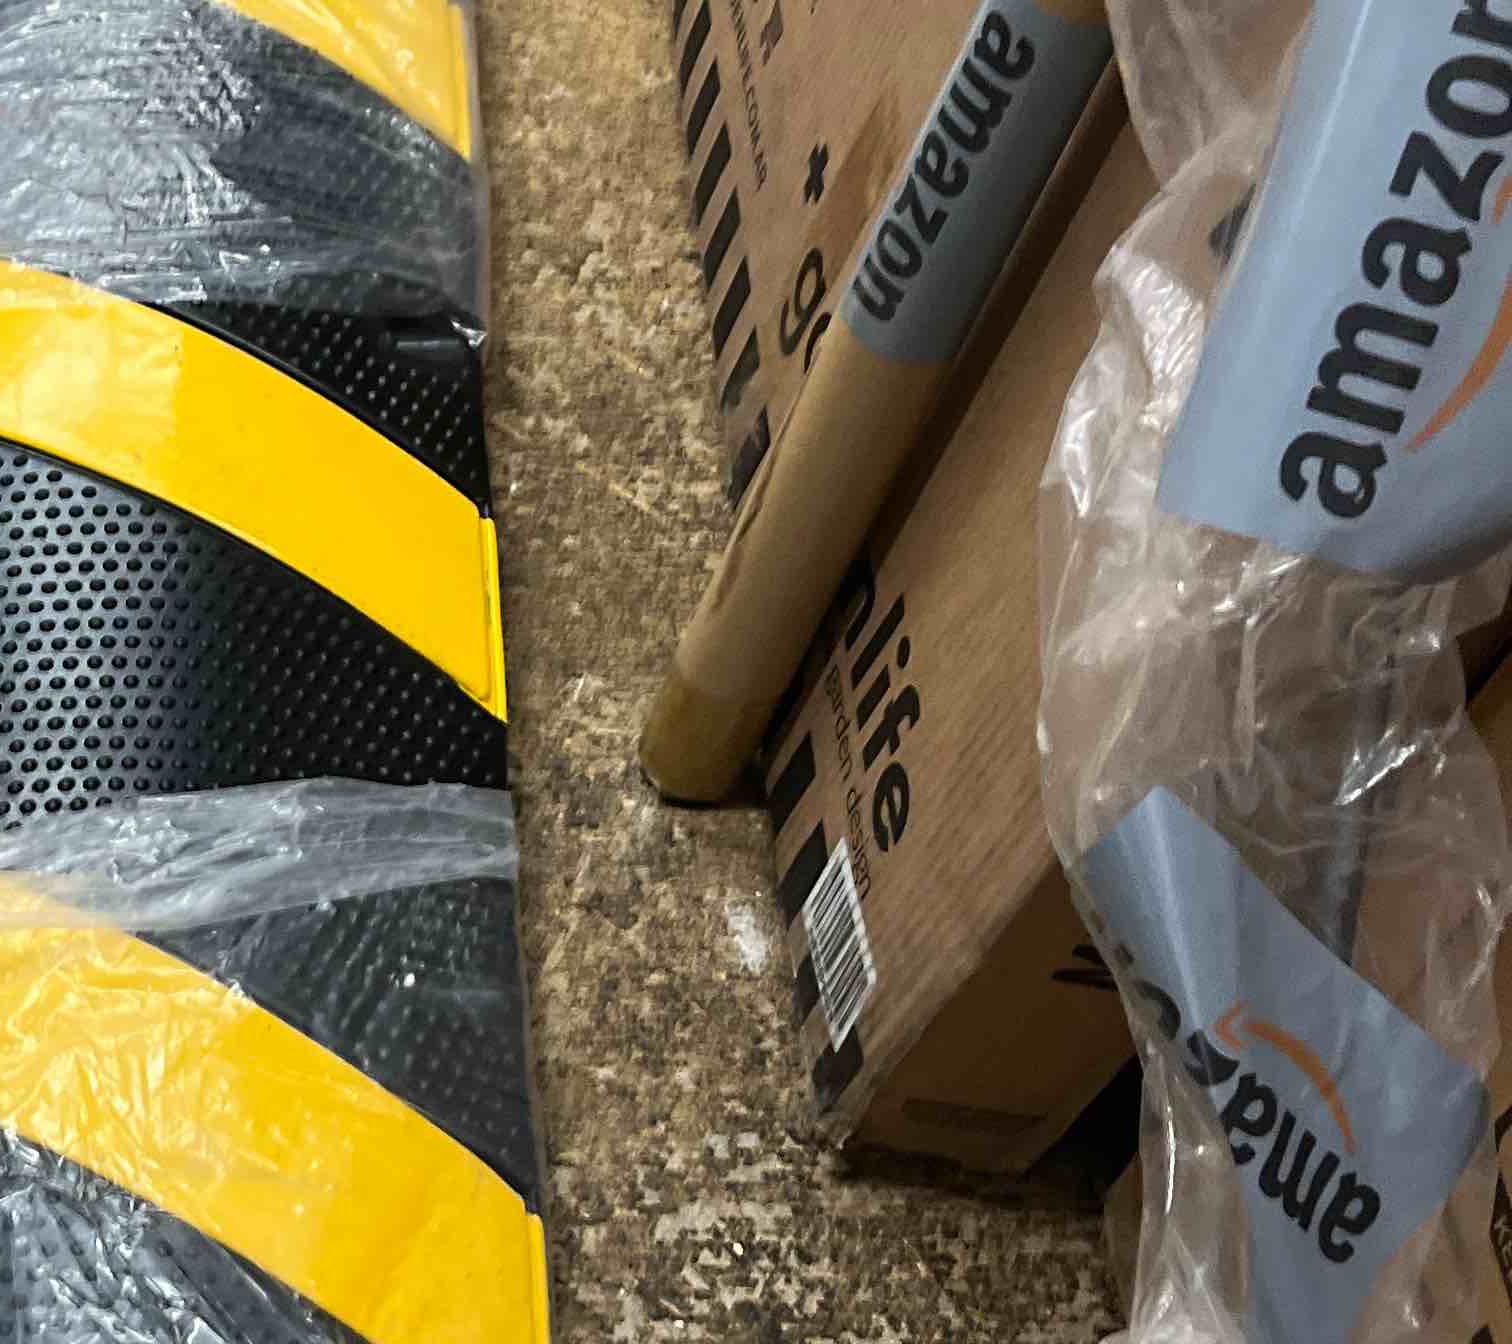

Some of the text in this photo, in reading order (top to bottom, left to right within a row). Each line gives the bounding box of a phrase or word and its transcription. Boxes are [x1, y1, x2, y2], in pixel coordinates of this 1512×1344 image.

[852, 10, 1036, 324] amazon
[824, 663, 872, 901] garden design
[1130, 964, 1381, 1263] ama
